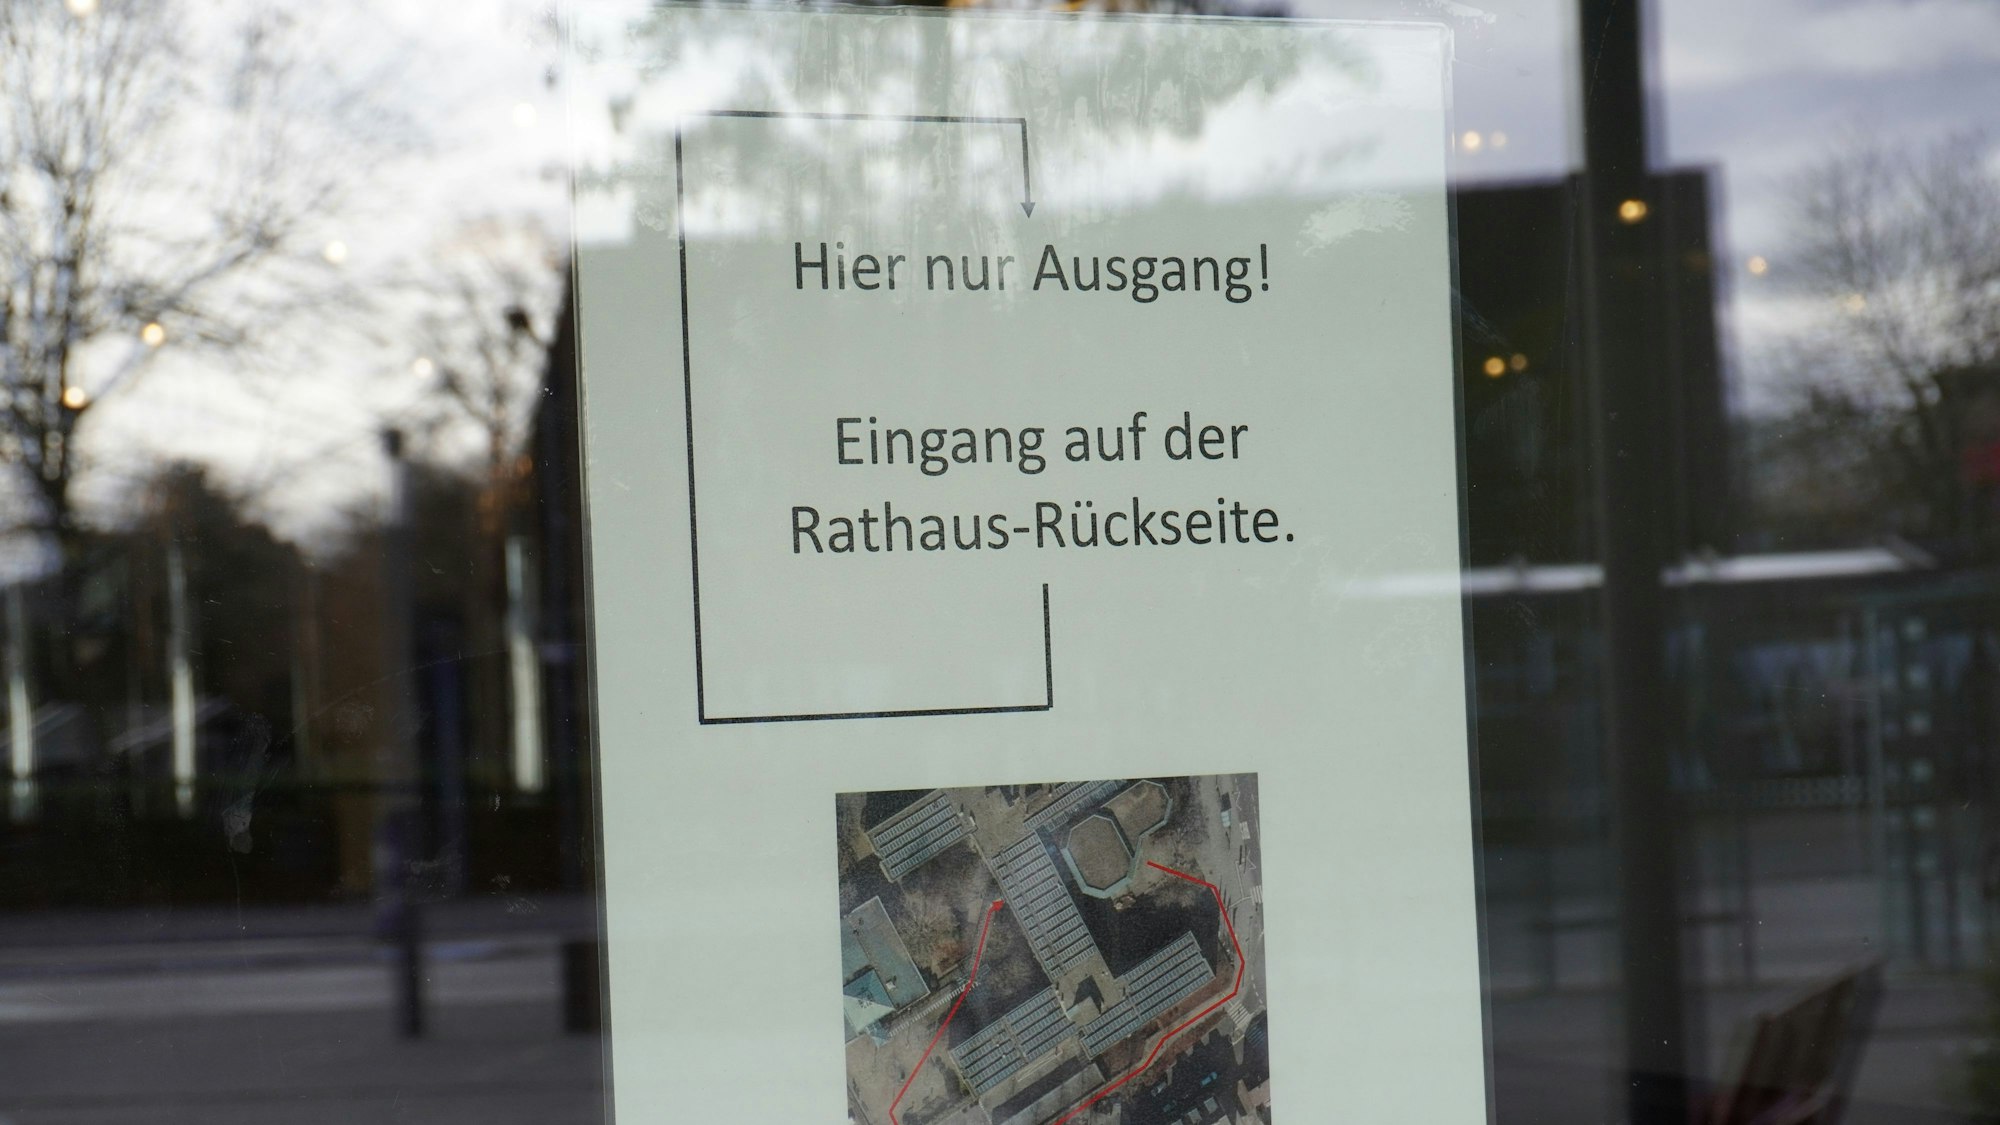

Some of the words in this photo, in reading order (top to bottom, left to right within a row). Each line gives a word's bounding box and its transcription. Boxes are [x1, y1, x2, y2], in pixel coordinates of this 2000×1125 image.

[794, 241, 906, 291] Hier
[926, 255, 1015, 291] nur
[1032, 243, 1269, 304] Ausgang!
[836, 416, 1047, 477] Eingang
[1064, 411, 1148, 463] auf
[1164, 410, 1249, 461] der
[791, 496, 1294, 554] Rathaus-Rückseite.
